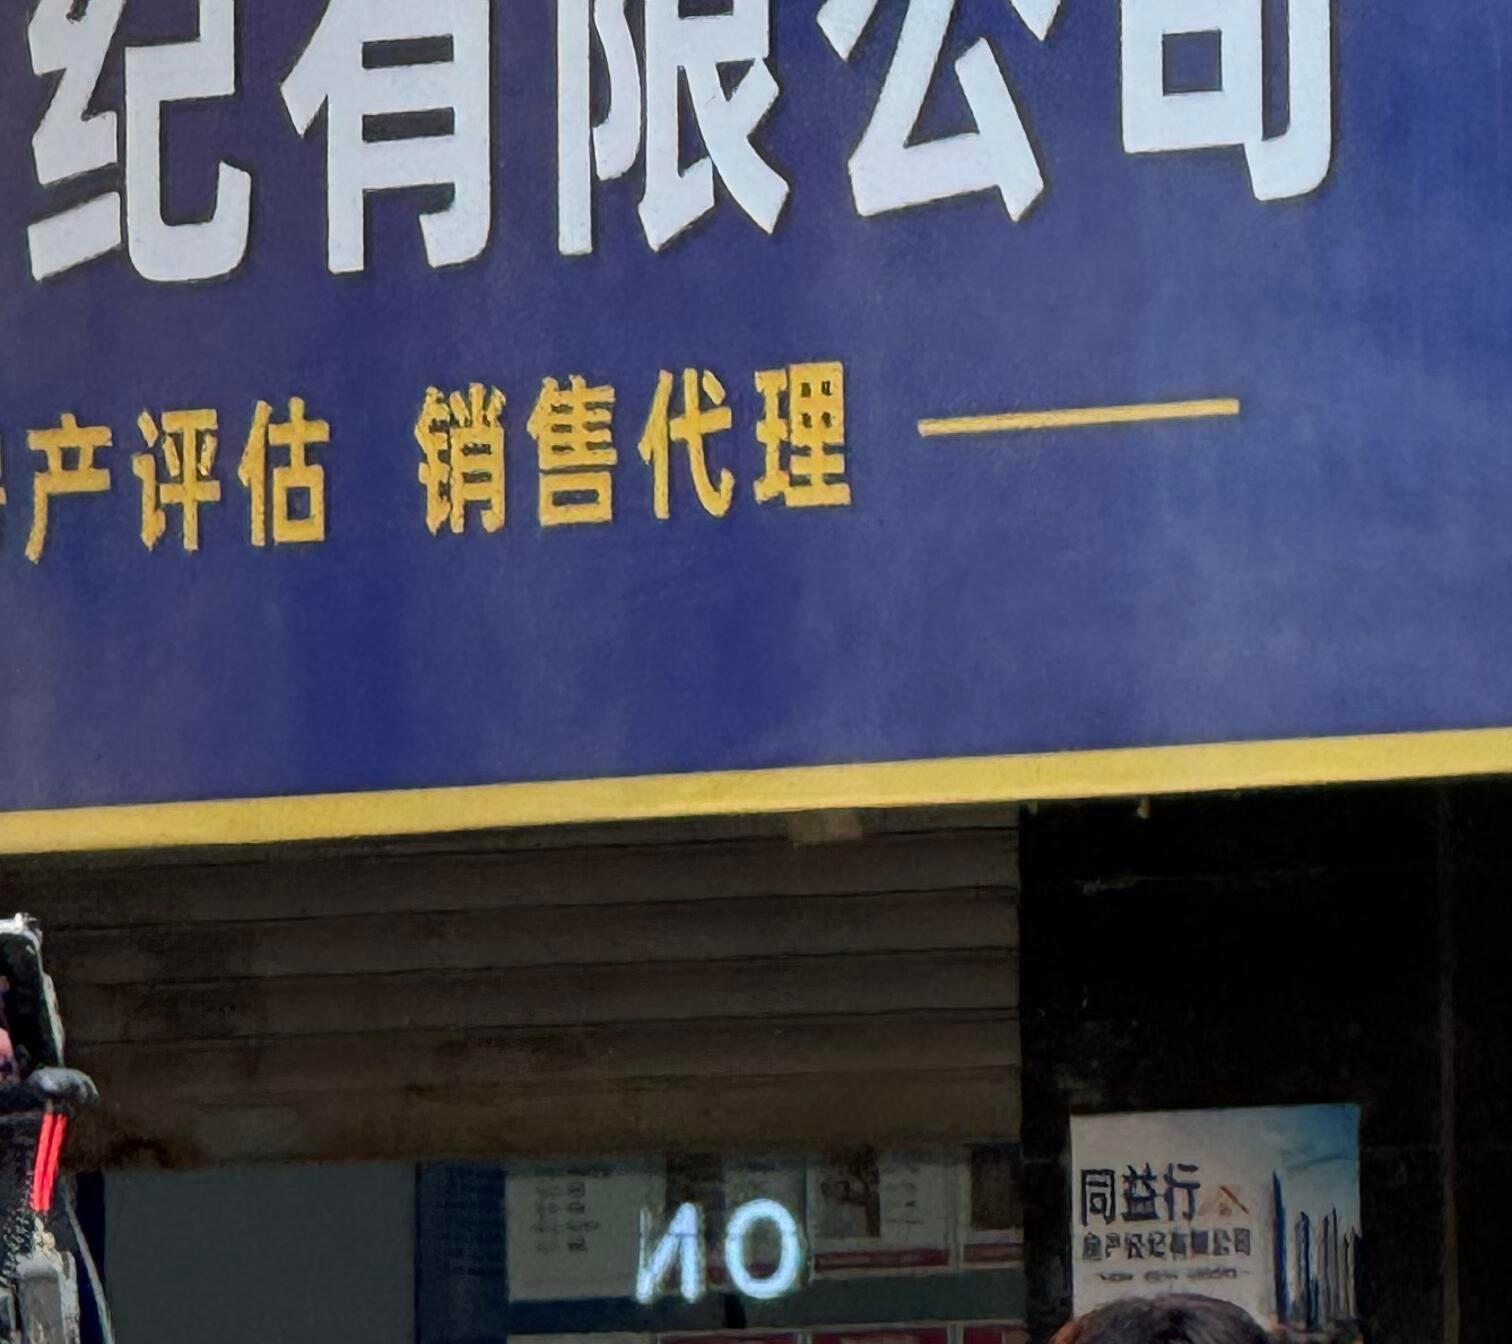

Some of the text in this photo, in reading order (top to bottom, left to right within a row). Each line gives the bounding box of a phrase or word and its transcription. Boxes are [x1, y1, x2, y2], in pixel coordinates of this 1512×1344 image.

[28, 0, 1332, 282] 纪有限公司
[0, 362, 852, 563] 产评估 销售代理
